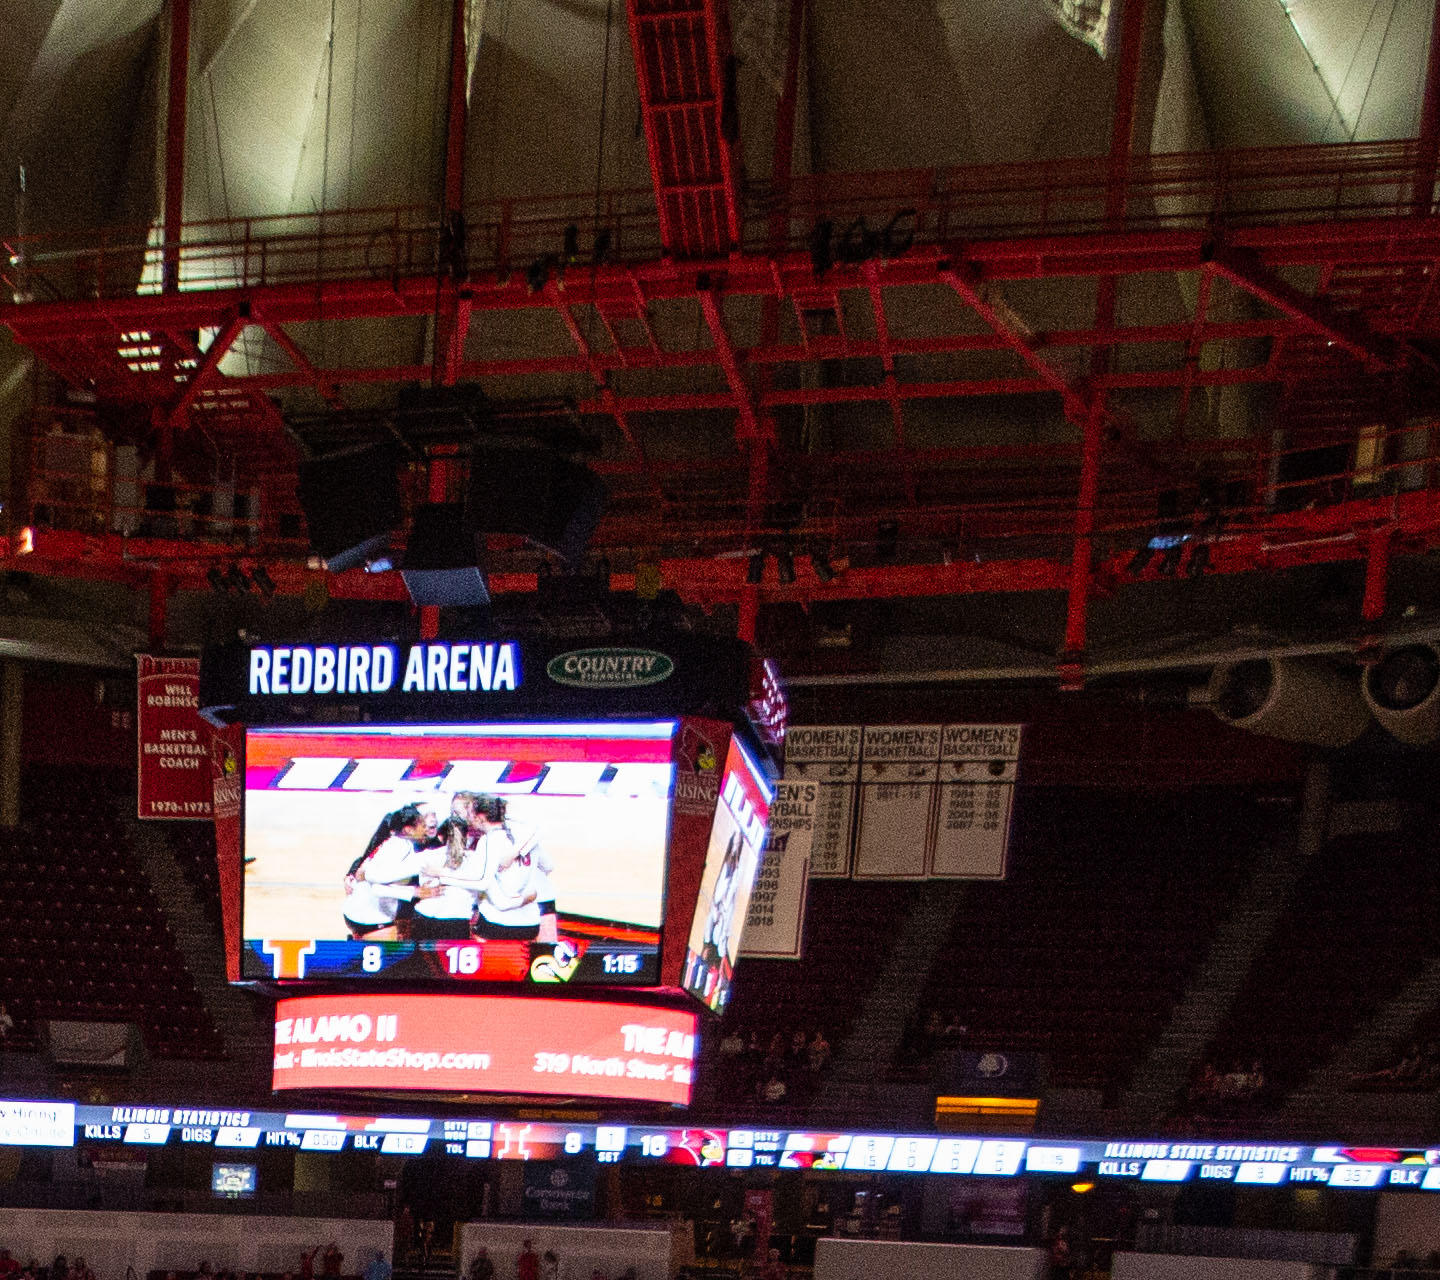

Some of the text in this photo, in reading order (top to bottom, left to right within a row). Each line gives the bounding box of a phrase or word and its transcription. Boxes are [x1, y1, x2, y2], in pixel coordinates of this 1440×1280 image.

[249, 646, 393, 694] REDBIRD
[403, 643, 516, 691] ARENA
[565, 654, 657, 674] COUNTRY
[164, 684, 193, 695] WILL
[789, 730, 859, 744] WOMEN'S
[867, 730, 938, 744] WOMEN'S
[945, 728, 1018, 743] WOMEN'S
[787, 745, 858, 757] BASKETBALL
[865, 745, 937, 757] BASKETBALL
[943, 743, 1014, 756] BASKETBALL
[159, 757, 201, 769] COACH
[362, 945, 382, 973] 8
[445, 946, 480, 974] 16
[602, 954, 637, 974] 1:15
[292, 1015, 371, 1043] ALAMO
[621, 1025, 666, 1052] THE
[533, 1052, 569, 1073] 319
[572, 1054, 625, 1077] North
[111, 1108, 250, 1126] ILLINOIS STATISTICS
[444, 1121, 467, 1131] SETS
[85, 1125, 121, 1139] KILLS
[182, 1127, 211, 1142] DIGS
[266, 1131, 300, 1145] HIT%
[355, 1133, 379, 1148] BLK
[565, 1131, 582, 1153] 8
[640, 1135, 667, 1156] 16
[598, 1151, 620, 1162] SET
[1105, 1144, 1299, 1162] ILLINOIS STATE STATISTICS
[1099, 1161, 1138, 1176] KILLS
[1201, 1164, 1232, 1179] DIGS
[1291, 1166, 1328, 1181] HIT%
[1391, 1169, 1418, 1184] BLK
